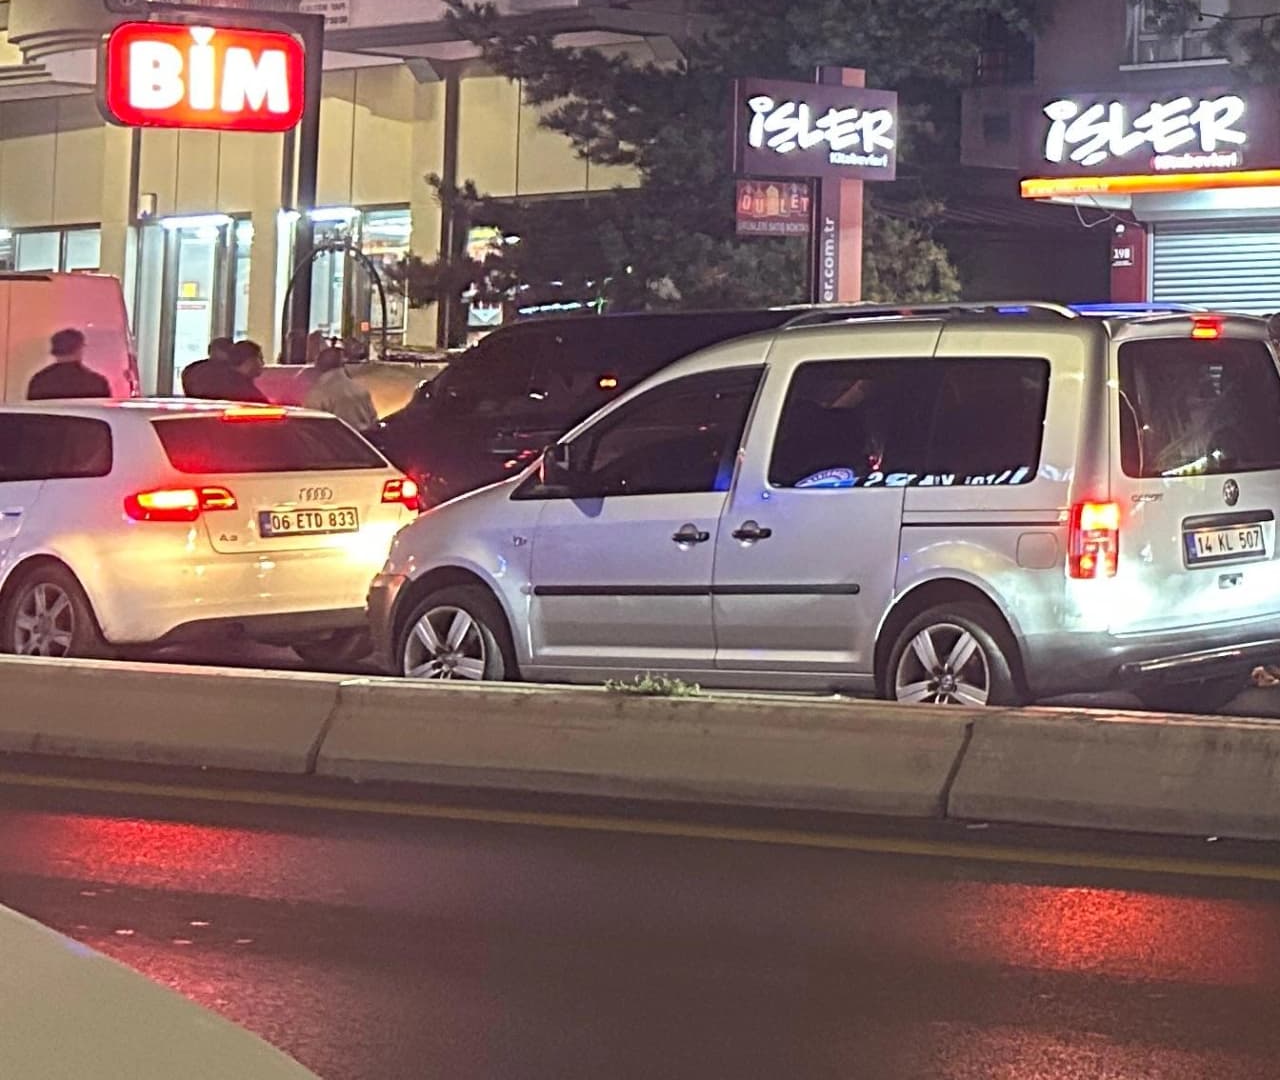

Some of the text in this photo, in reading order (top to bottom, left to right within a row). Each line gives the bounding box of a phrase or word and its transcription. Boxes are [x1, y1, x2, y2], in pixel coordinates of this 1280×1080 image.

[129, 26, 290, 114] BİM
[271, 511, 355, 530] 06 ETD 833
[1197, 530, 1260, 554] 14 KL 507
